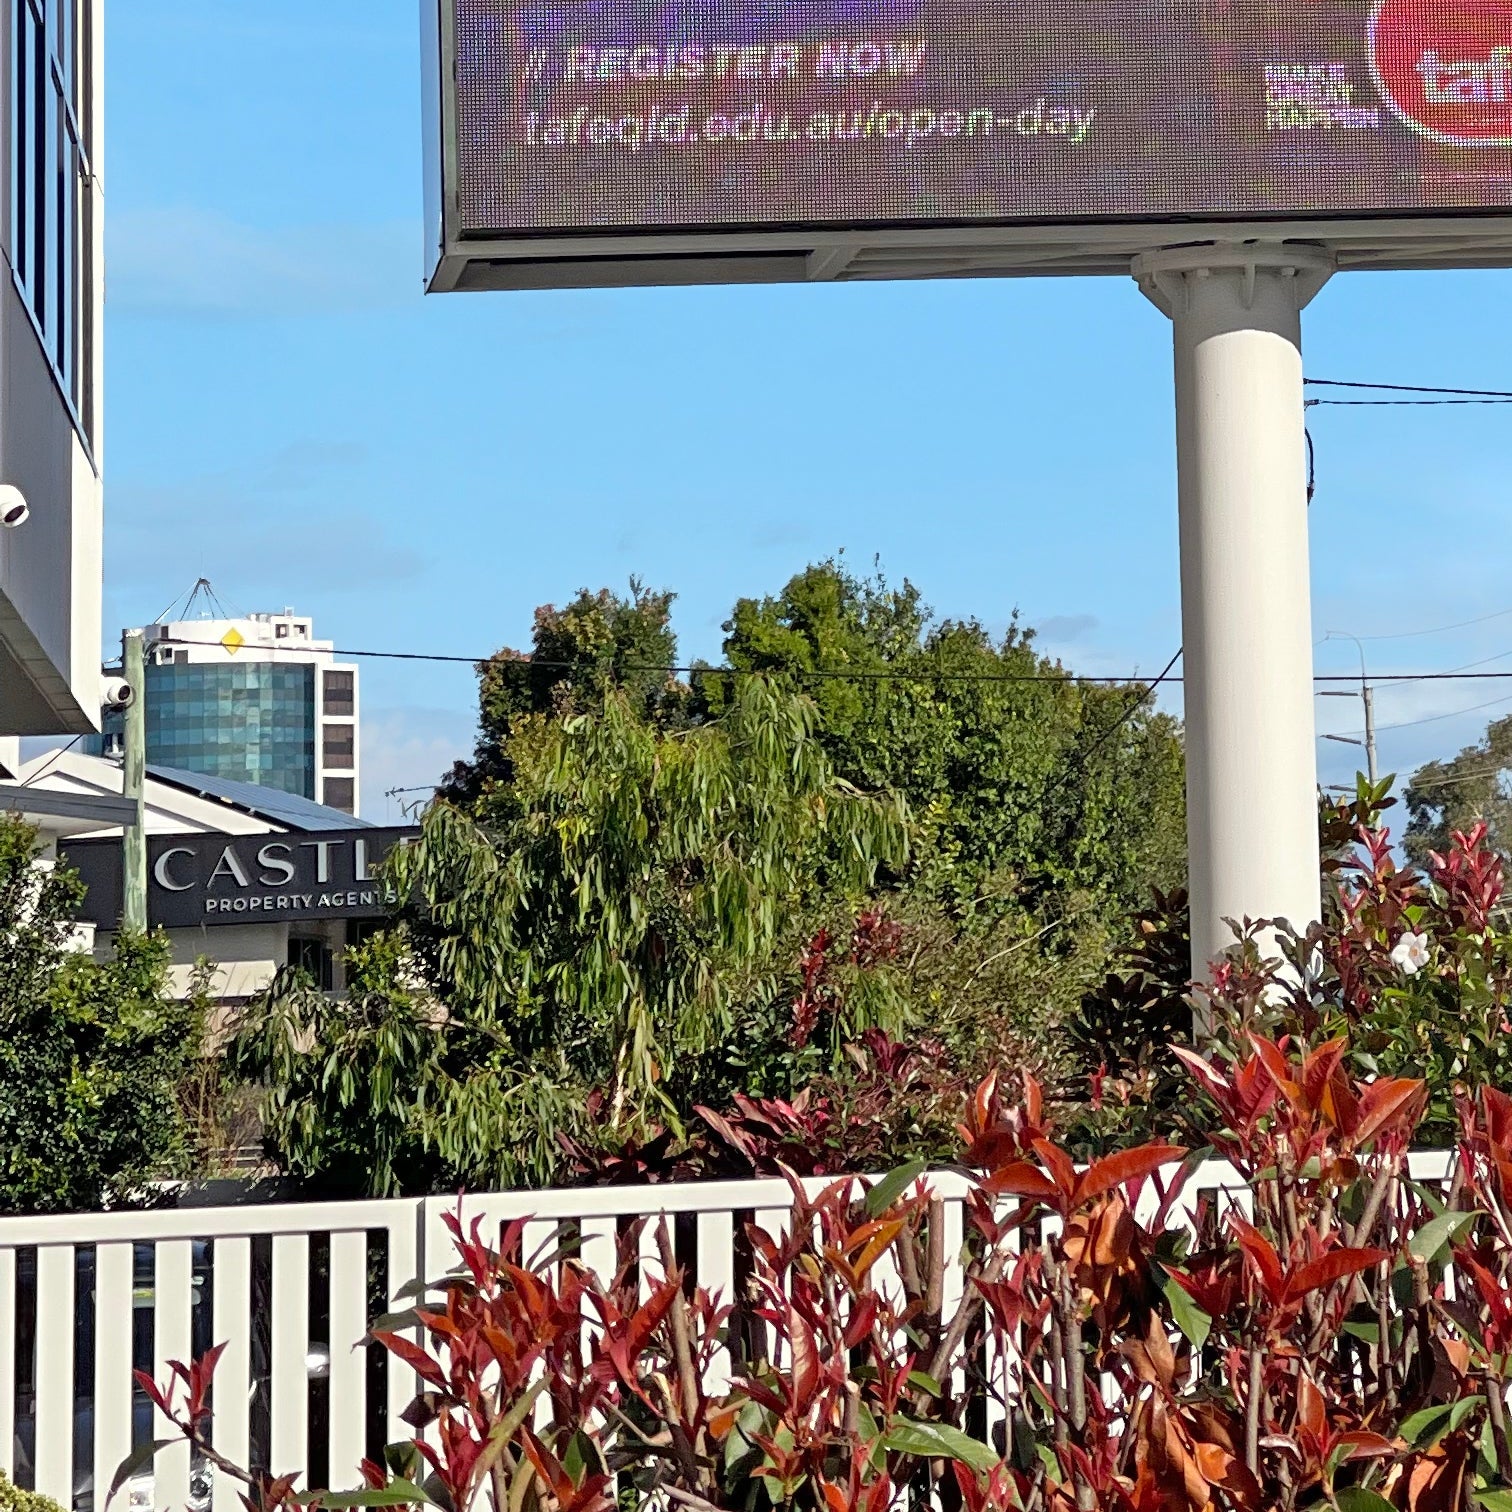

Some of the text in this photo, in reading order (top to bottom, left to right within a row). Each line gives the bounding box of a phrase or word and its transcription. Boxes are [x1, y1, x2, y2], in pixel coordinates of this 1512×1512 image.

[564, 41, 801, 83] REGISTER
[814, 37, 927, 79] NOW
[1264, 63, 1346, 81] MAKE
[524, 96, 1099, 154] tafeqld.edu.au/open-day
[1264, 107, 1380, 131] HAPPEN
[154, 836, 421, 891] CASTL
[206, 892, 312, 913] PROPERTY
